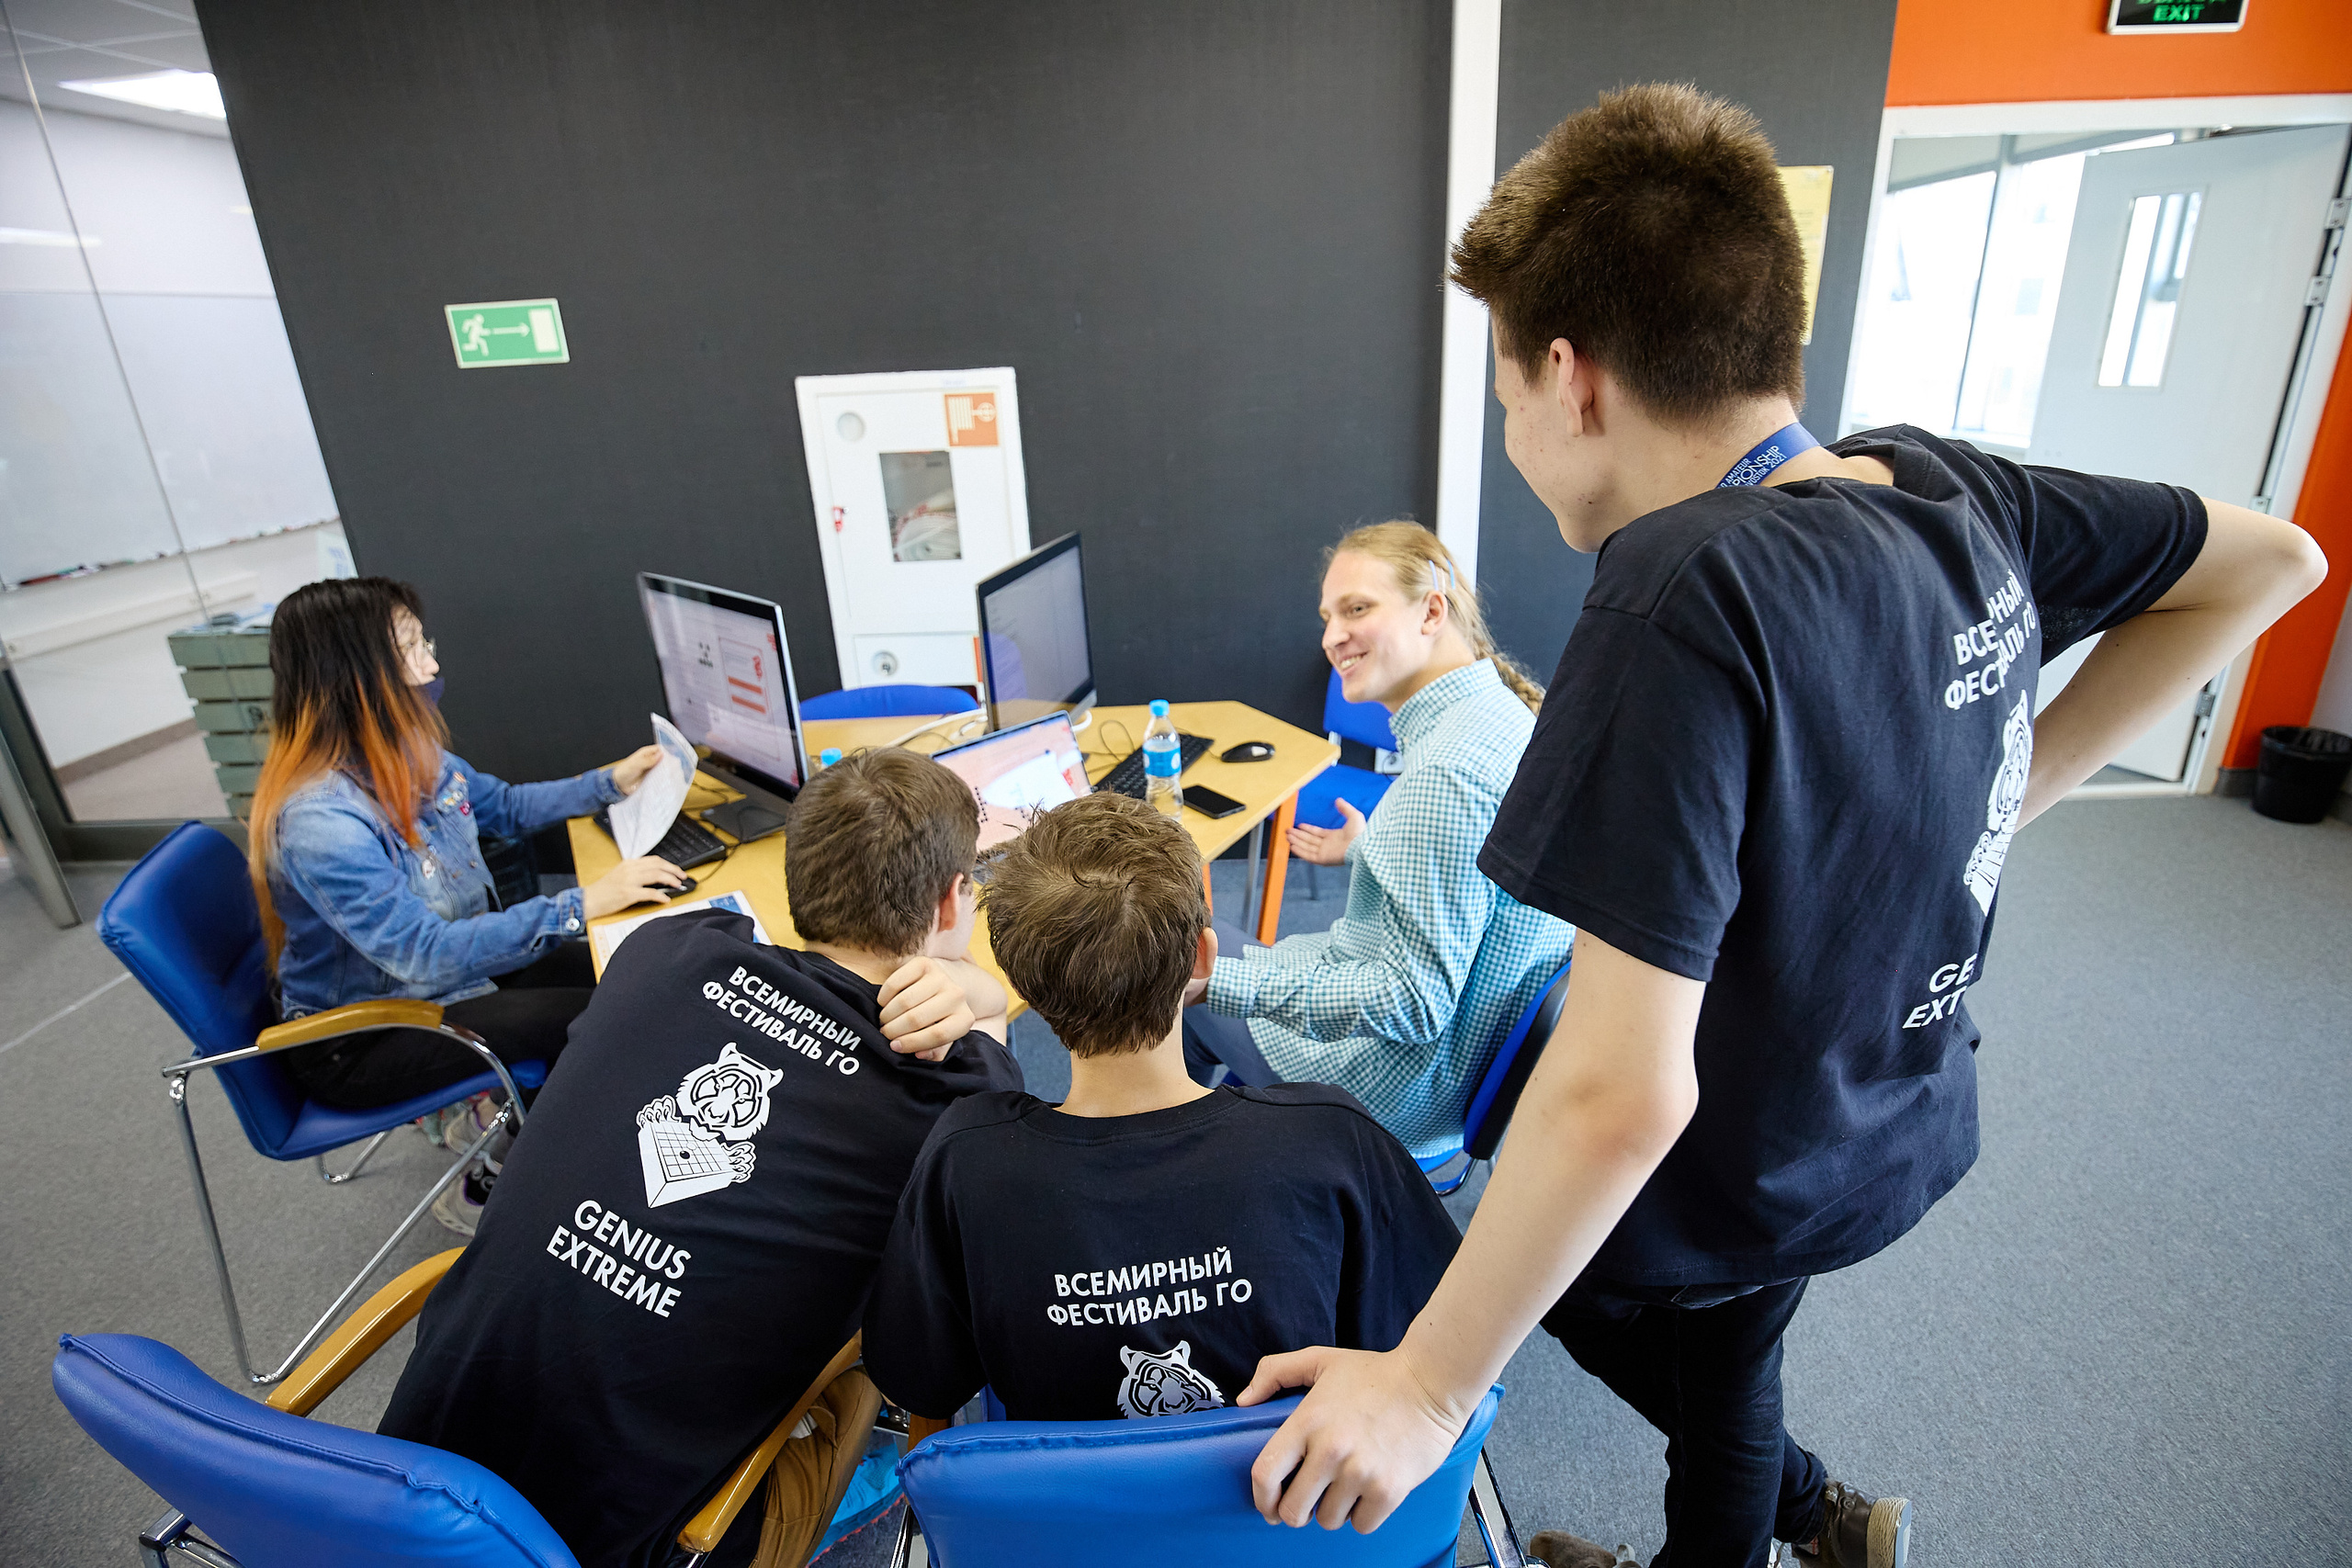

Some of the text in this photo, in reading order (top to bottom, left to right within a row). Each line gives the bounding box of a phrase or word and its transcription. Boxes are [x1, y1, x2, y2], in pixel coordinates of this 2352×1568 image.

[2153, 4, 2205, 22] EXIT
[1724, 457, 1752, 484] AMATEUR
[1731, 446, 1781, 487] PIONSHIP
[1768, 453, 1788, 468] 2021
[2022, 601, 2036, 638] ГО
[701, 980, 860, 1077] ФЕСТИВАЛЬ ГО
[573, 1200, 692, 1280] GENIUS
[546, 1225, 682, 1318] EXTREME
[1054, 1246, 1233, 1297] ВСЕМИРНЫЙ
[1046, 1278, 1252, 1325] ФЕСТИВАЛЬ ГО
